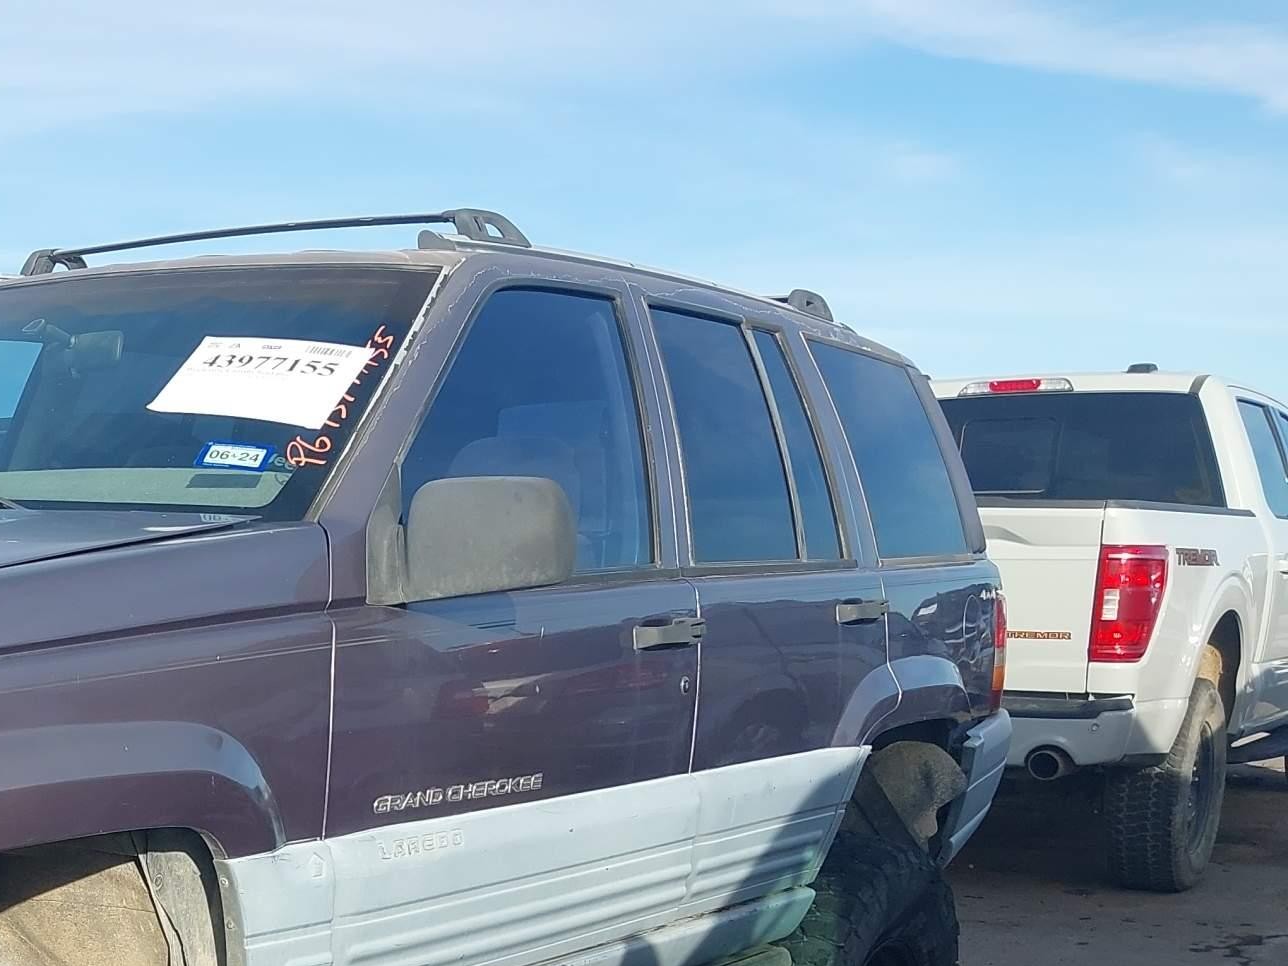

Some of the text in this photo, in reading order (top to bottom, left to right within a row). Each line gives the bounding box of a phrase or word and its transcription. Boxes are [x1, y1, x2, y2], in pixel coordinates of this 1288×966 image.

[202, 354, 340, 377] 43977155
[1176, 548, 1220, 566] TREMOR
[1007, 630, 1072, 641] TREMOR
[373, 773, 544, 814] GRAND CHEROKEE
